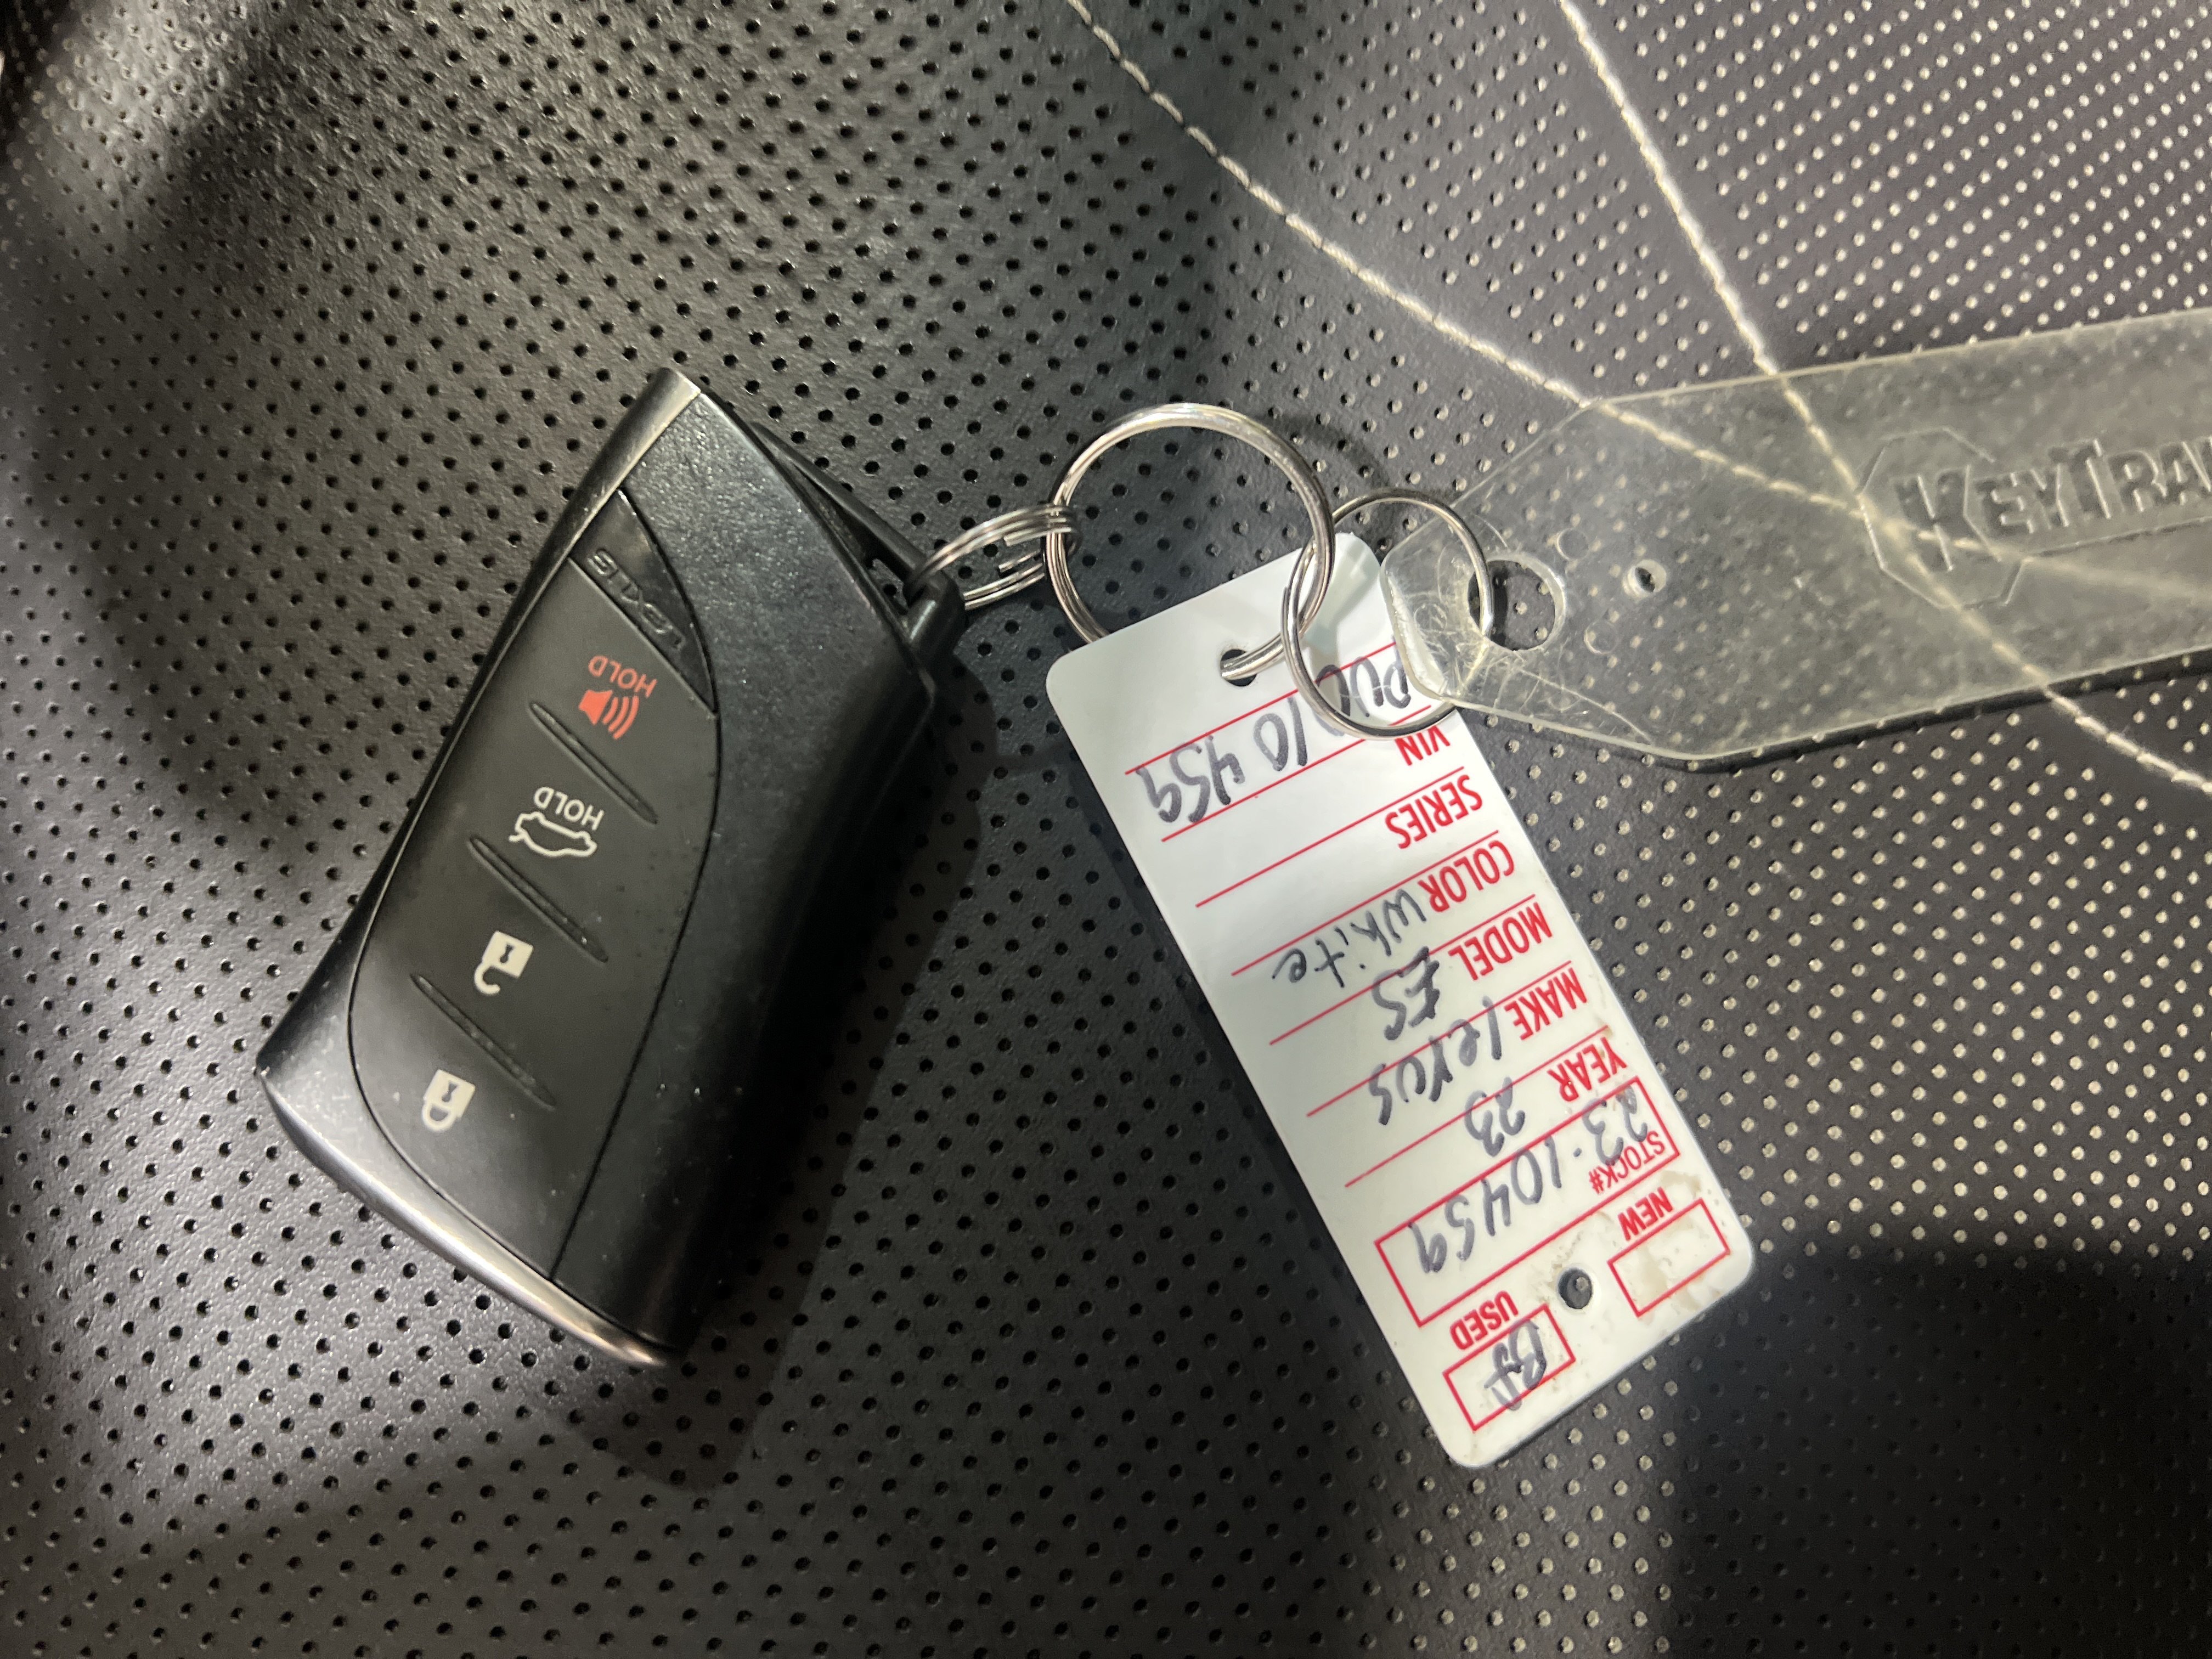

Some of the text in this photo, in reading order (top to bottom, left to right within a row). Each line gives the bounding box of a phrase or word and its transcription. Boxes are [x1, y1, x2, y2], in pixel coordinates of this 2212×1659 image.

[1889, 437, 2212, 572] KEYTRA
[586, 548, 686, 651] LEXUS
[588, 655, 657, 698] HOLD
[1395, 725, 1451, 766] VIN
[533, 786, 604, 831] HOLD
[1385, 774, 1483, 849] SERIES
[1417, 839, 1515, 913] COLOR
[1448, 901, 1553, 981] MODEL
[1372, 945, 1440, 1040] ES
[1503, 967, 1588, 1041] MAKE
[1546, 1036, 1627, 1102] YEAR
[1464, 1076, 1525, 1157] 23
[1589, 1130, 1665, 1195] STOCK#
[1618, 1187, 1675, 1242] NEW
[1449, 1290, 1519, 1351] USED
